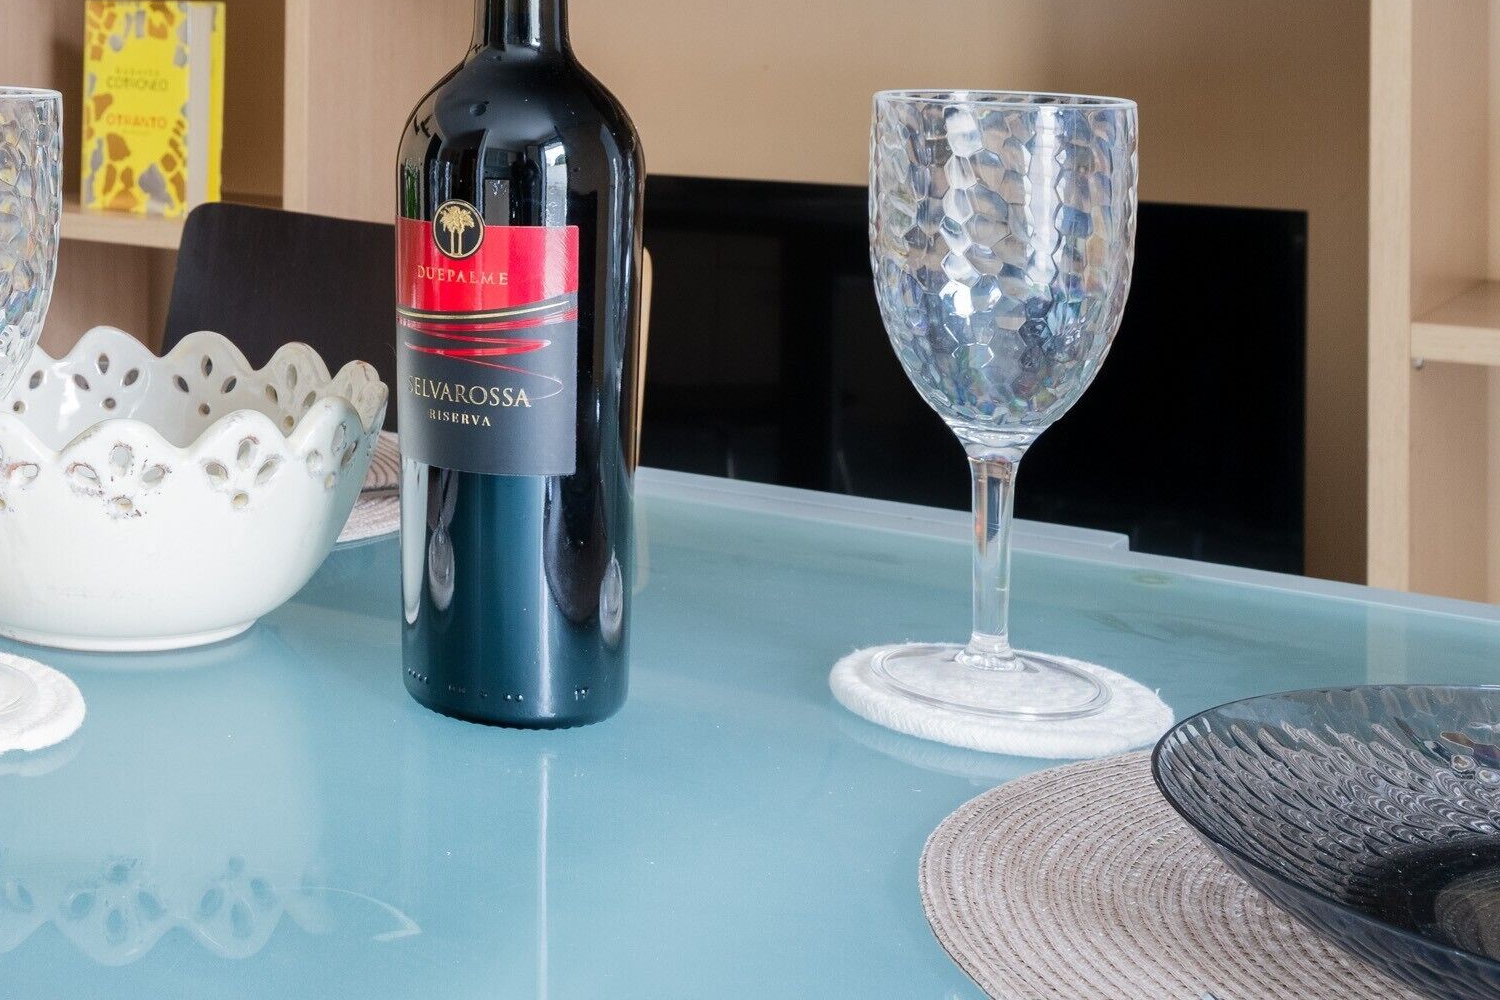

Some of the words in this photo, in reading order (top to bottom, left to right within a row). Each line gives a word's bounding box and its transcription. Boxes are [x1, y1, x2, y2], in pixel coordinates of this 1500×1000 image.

[417, 265, 509, 286] DUEPALME
[406, 375, 532, 409] SELVAROSSA
[429, 408, 492, 427] RISERVA
